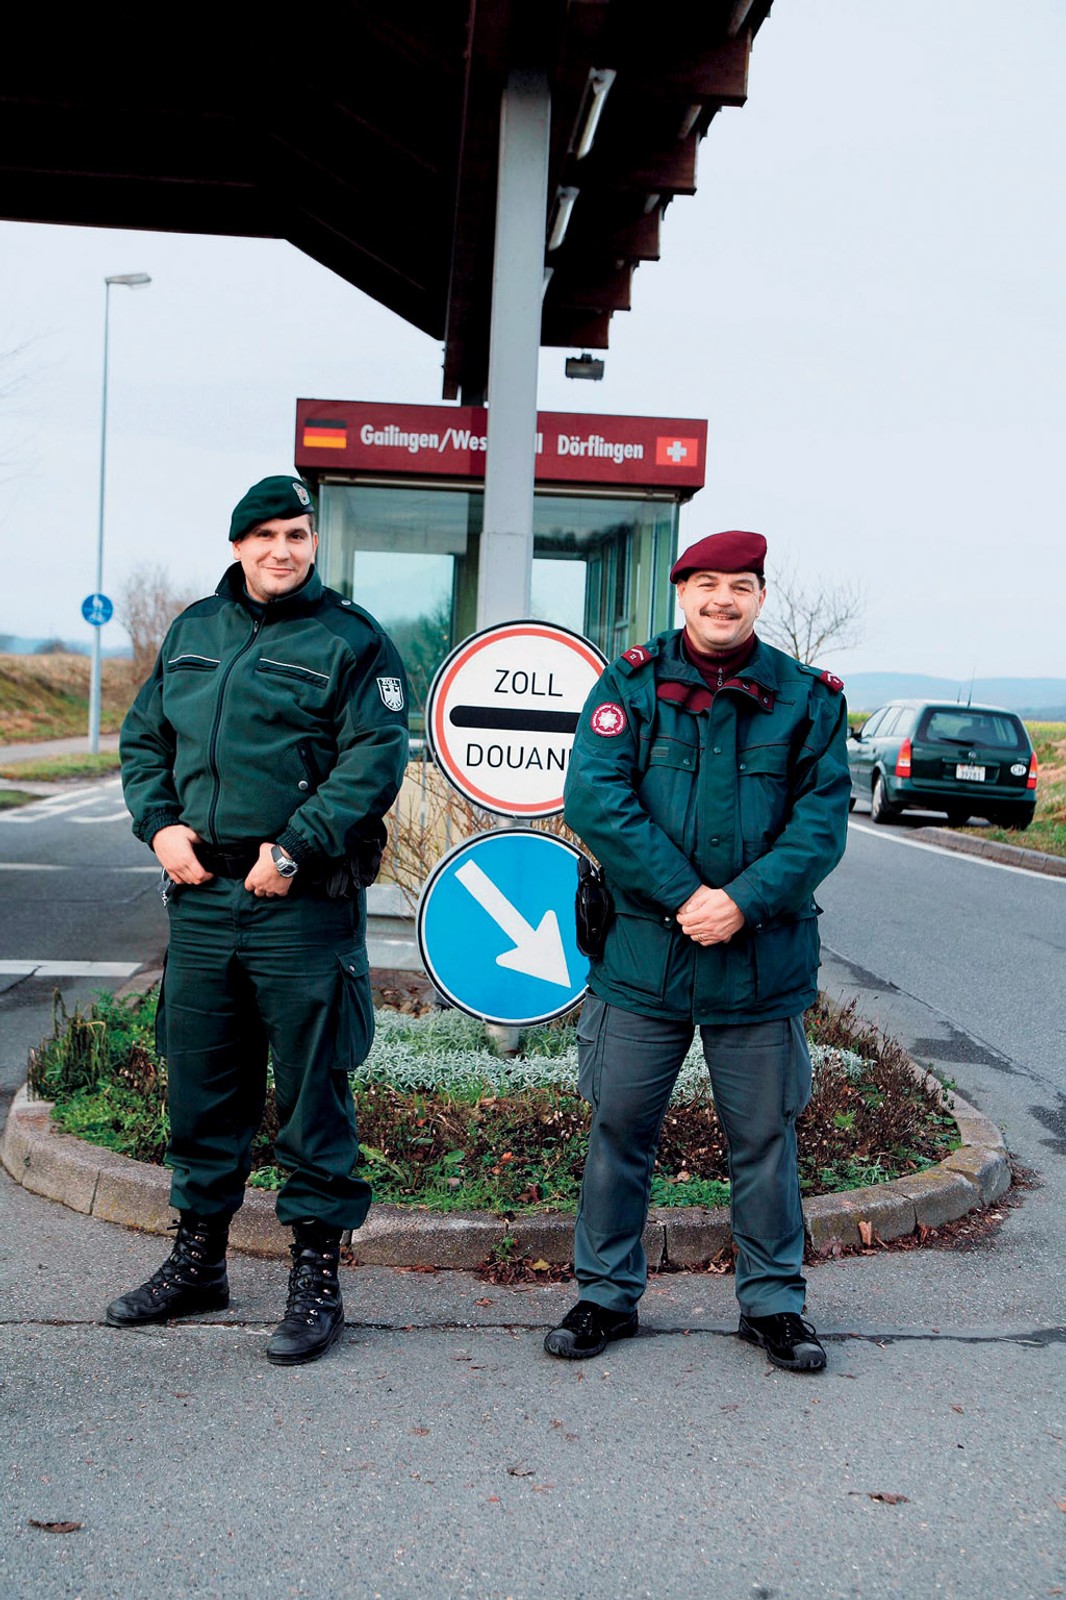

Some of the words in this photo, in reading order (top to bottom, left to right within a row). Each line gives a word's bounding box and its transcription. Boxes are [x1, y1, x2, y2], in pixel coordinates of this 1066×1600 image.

[360, 424, 488, 453] Gailingen/Wes
[557, 434, 643, 463] Dörflingen
[494, 669, 563, 697] ZOLL
[466, 743, 572, 771] DOUAN
